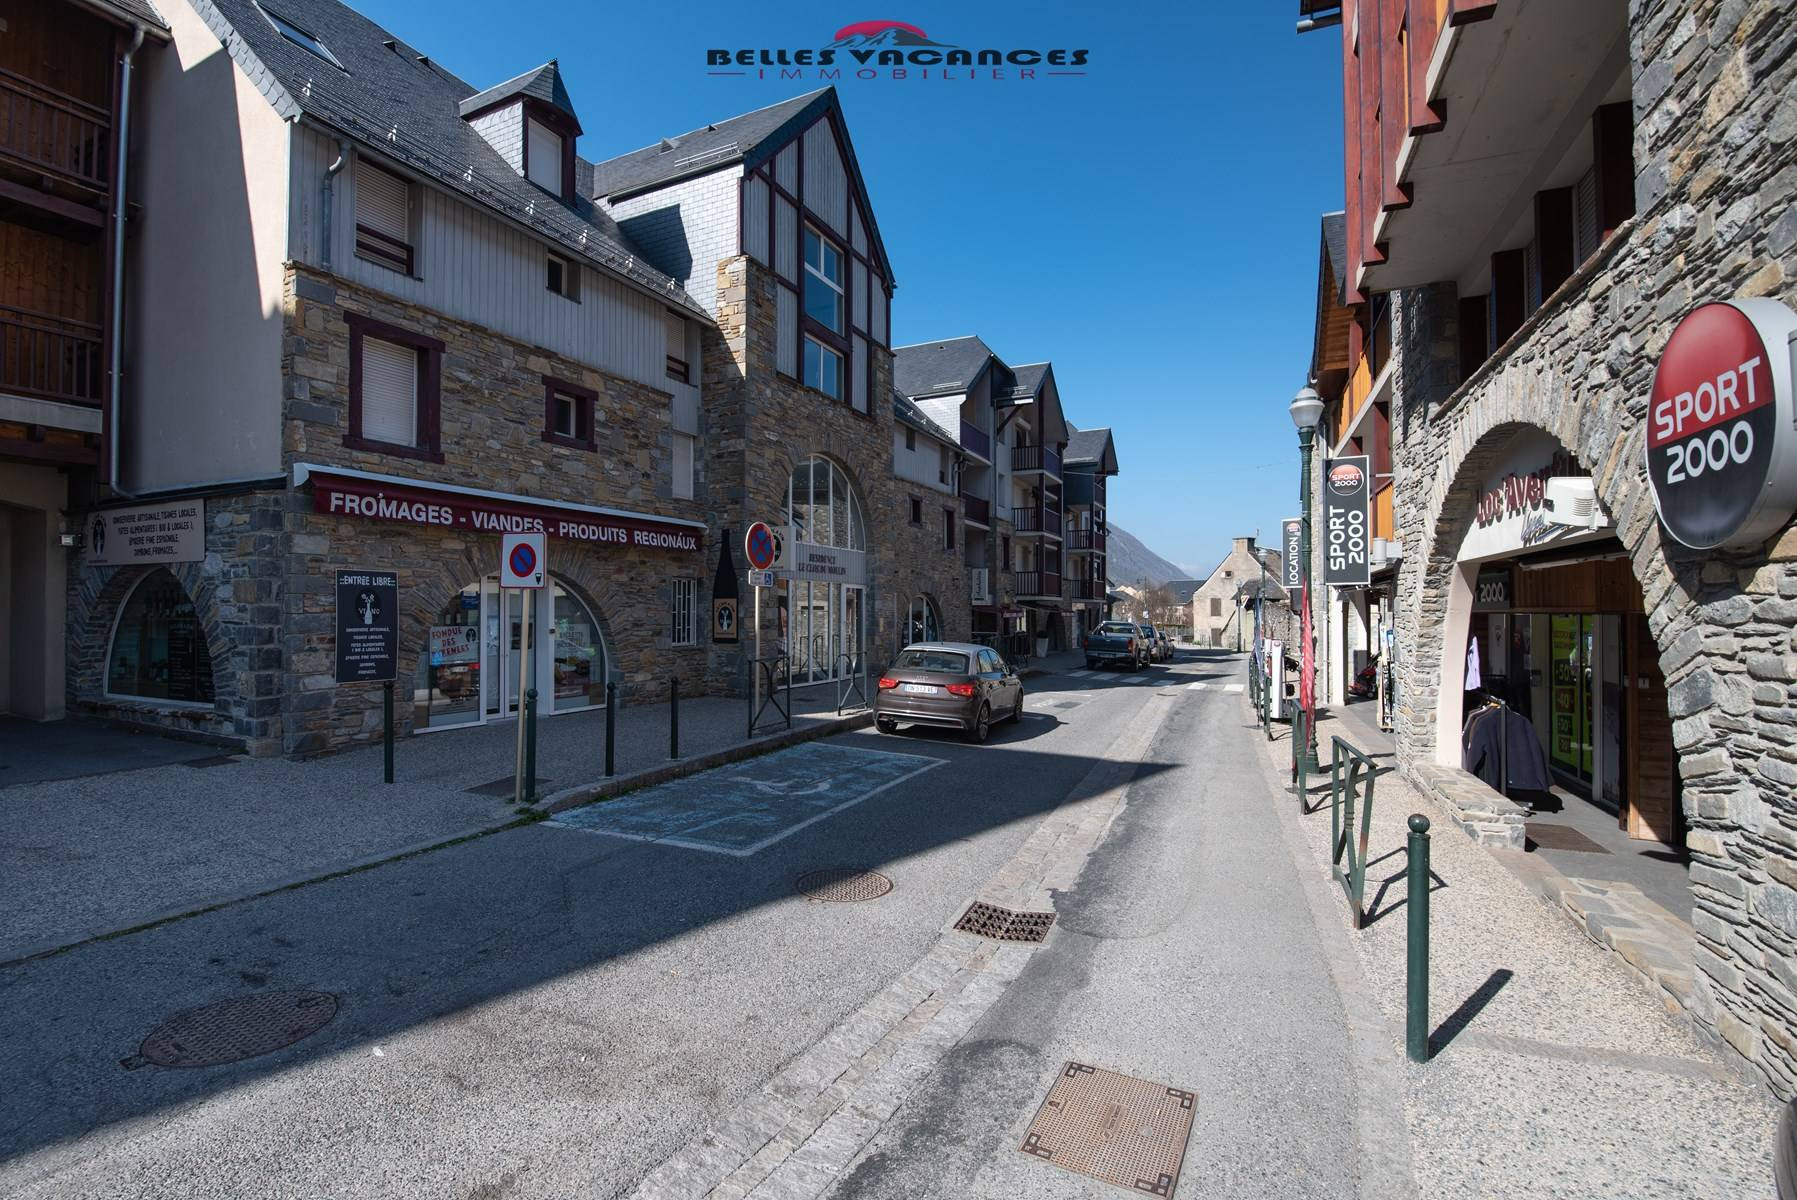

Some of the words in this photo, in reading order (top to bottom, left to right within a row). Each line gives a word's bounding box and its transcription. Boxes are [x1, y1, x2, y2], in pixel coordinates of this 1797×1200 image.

[1654, 355, 1761, 440] SPORT
[1331, 473, 1360, 481] SPORT
[1666, 420, 1754, 485] 2000
[329, 491, 454, 525] FROMAGES
[471, 510, 544, 533] VIANDES
[559, 521, 628, 544] PRODUITS
[1329, 505, 1346, 571] SPORT
[1347, 510, 1364, 564] 2000
[372, 576, 391, 586] LIBRE
[1289, 536, 1299, 585] LOCATION
[1480, 581, 1505, 603] 2000
[432, 627, 463, 639] FONDUE
[441, 637, 456, 647] DES
